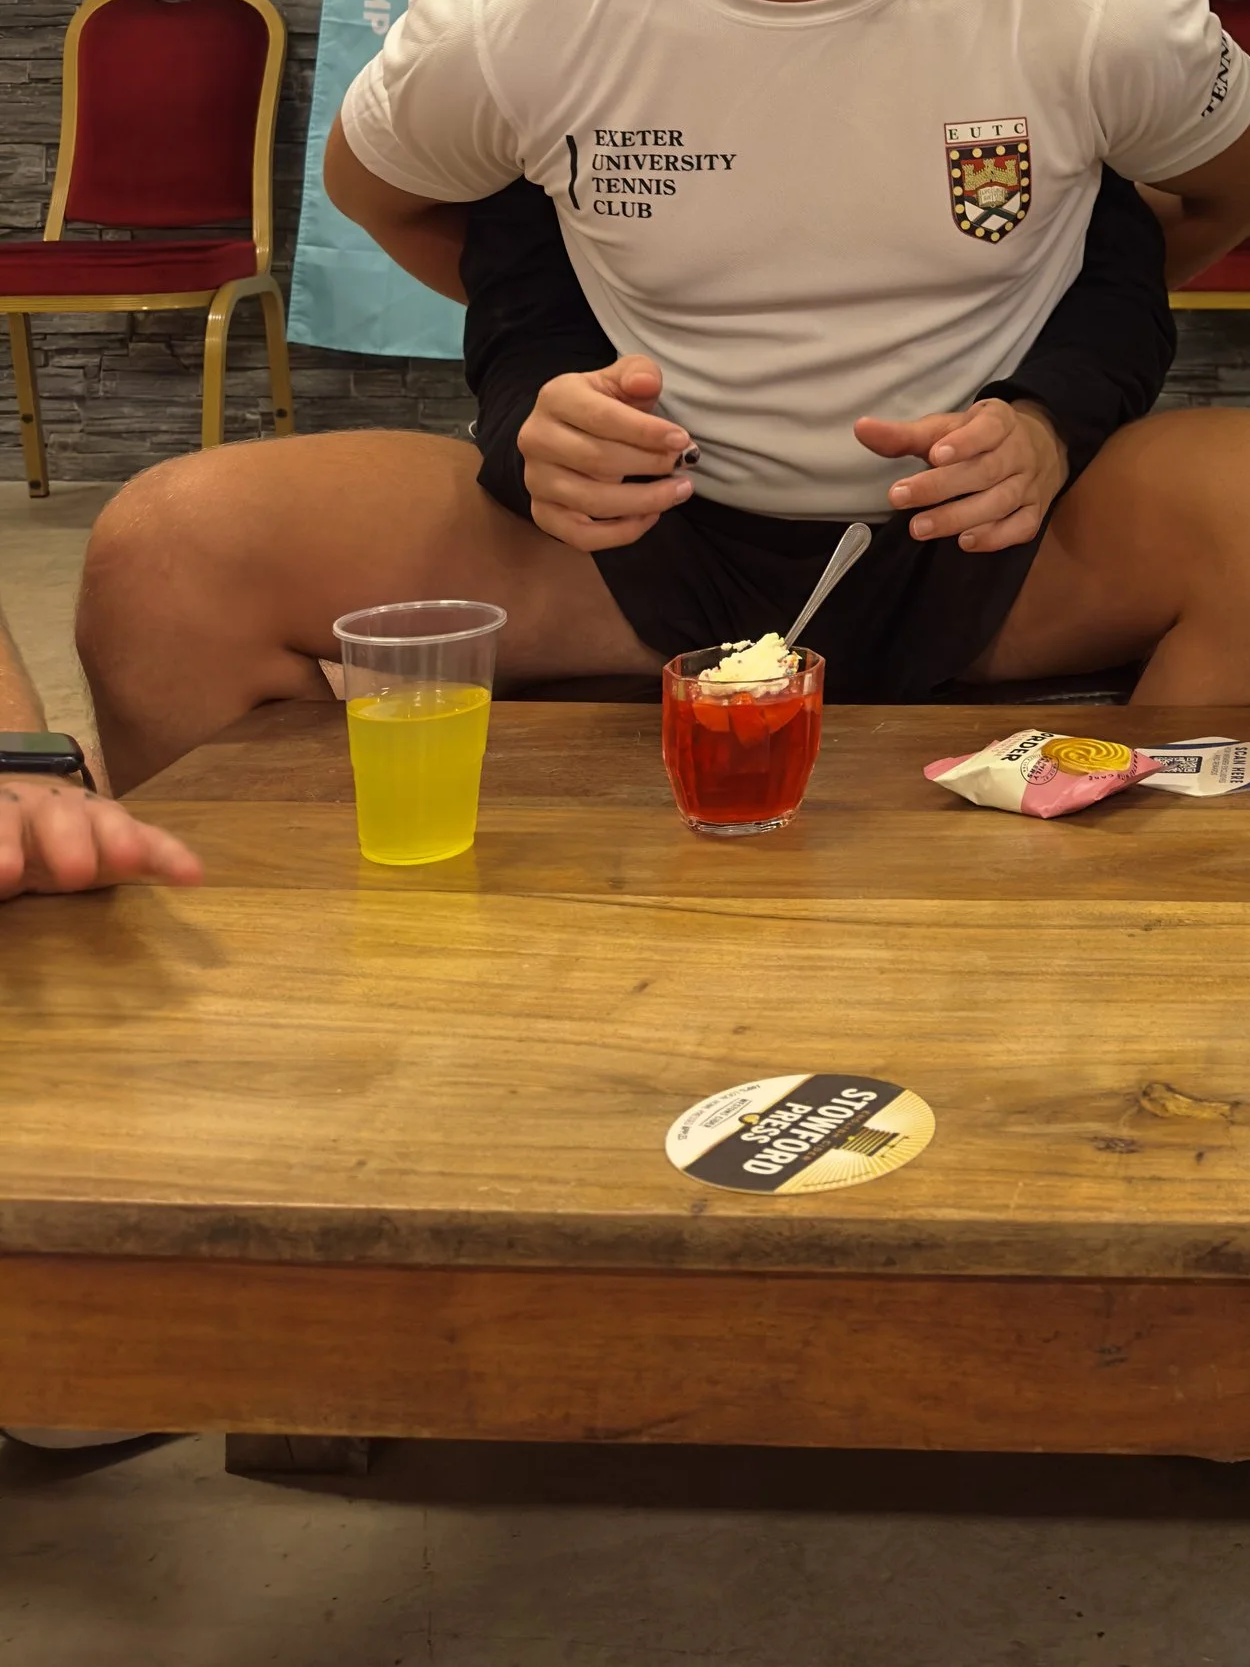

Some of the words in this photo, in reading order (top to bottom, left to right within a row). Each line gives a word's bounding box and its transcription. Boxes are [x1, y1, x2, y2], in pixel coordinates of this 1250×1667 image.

[593, 129, 685, 148] EXETER
[592, 153, 737, 172] UNIVERSITY
[592, 177, 677, 196] TENNIS
[593, 199, 653, 219] CLUB
[1232, 746, 1248, 765] SCAN
[1230, 767, 1245, 784] HERE
[740, 1101, 814, 1144] PRESS
[742, 1087, 878, 1176] STOWFORD
